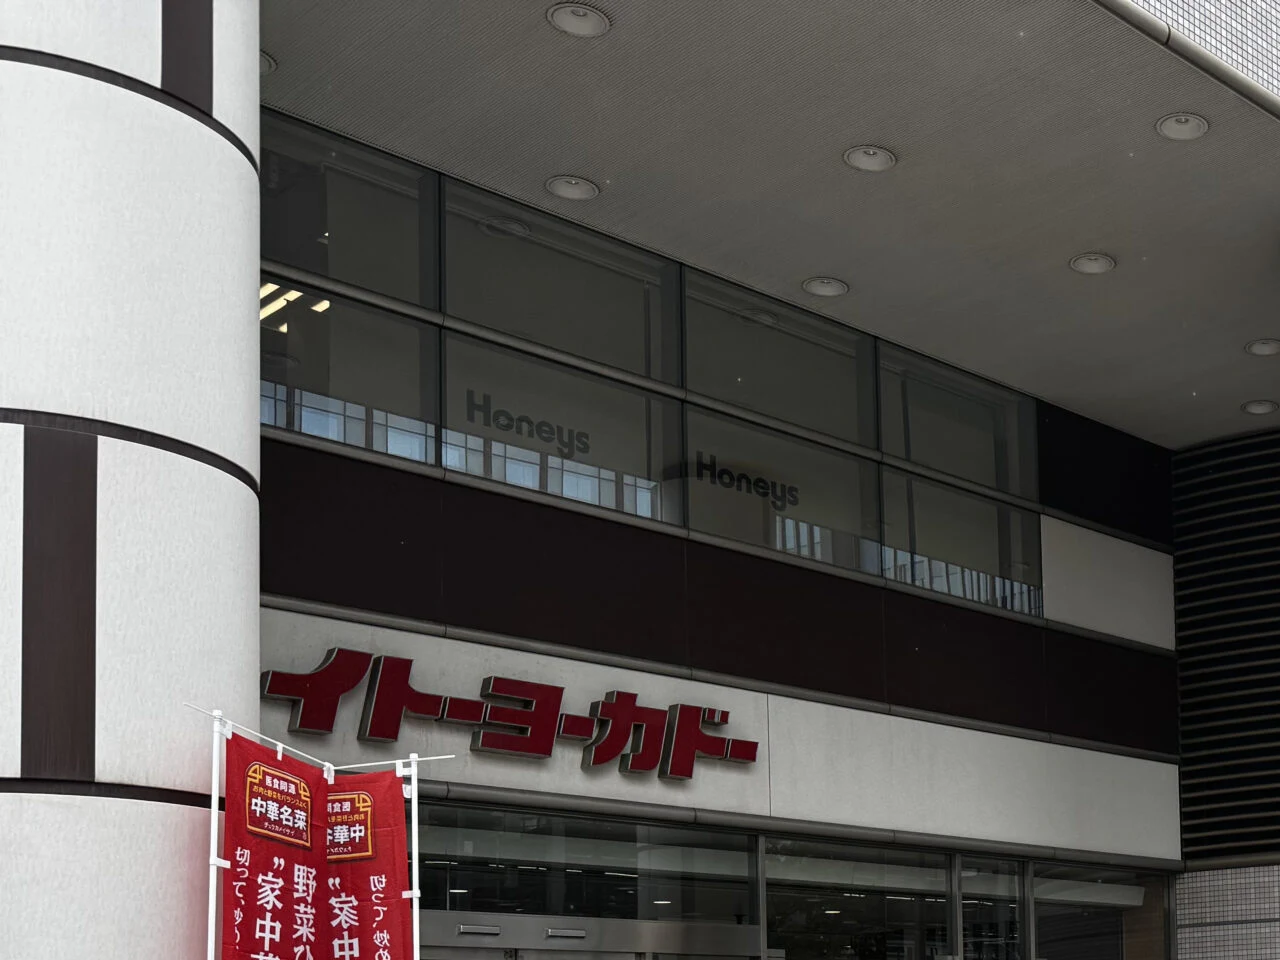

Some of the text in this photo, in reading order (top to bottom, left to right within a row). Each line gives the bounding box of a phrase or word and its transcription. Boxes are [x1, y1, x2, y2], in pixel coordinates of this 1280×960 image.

[467, 388, 591, 460] Honeys
[696, 451, 800, 512] Honeys
[261, 646, 758, 781] イトーヨーカドー
[251, 796, 307, 831] 中華名菜
[265, 775, 296, 795] 医食同源
